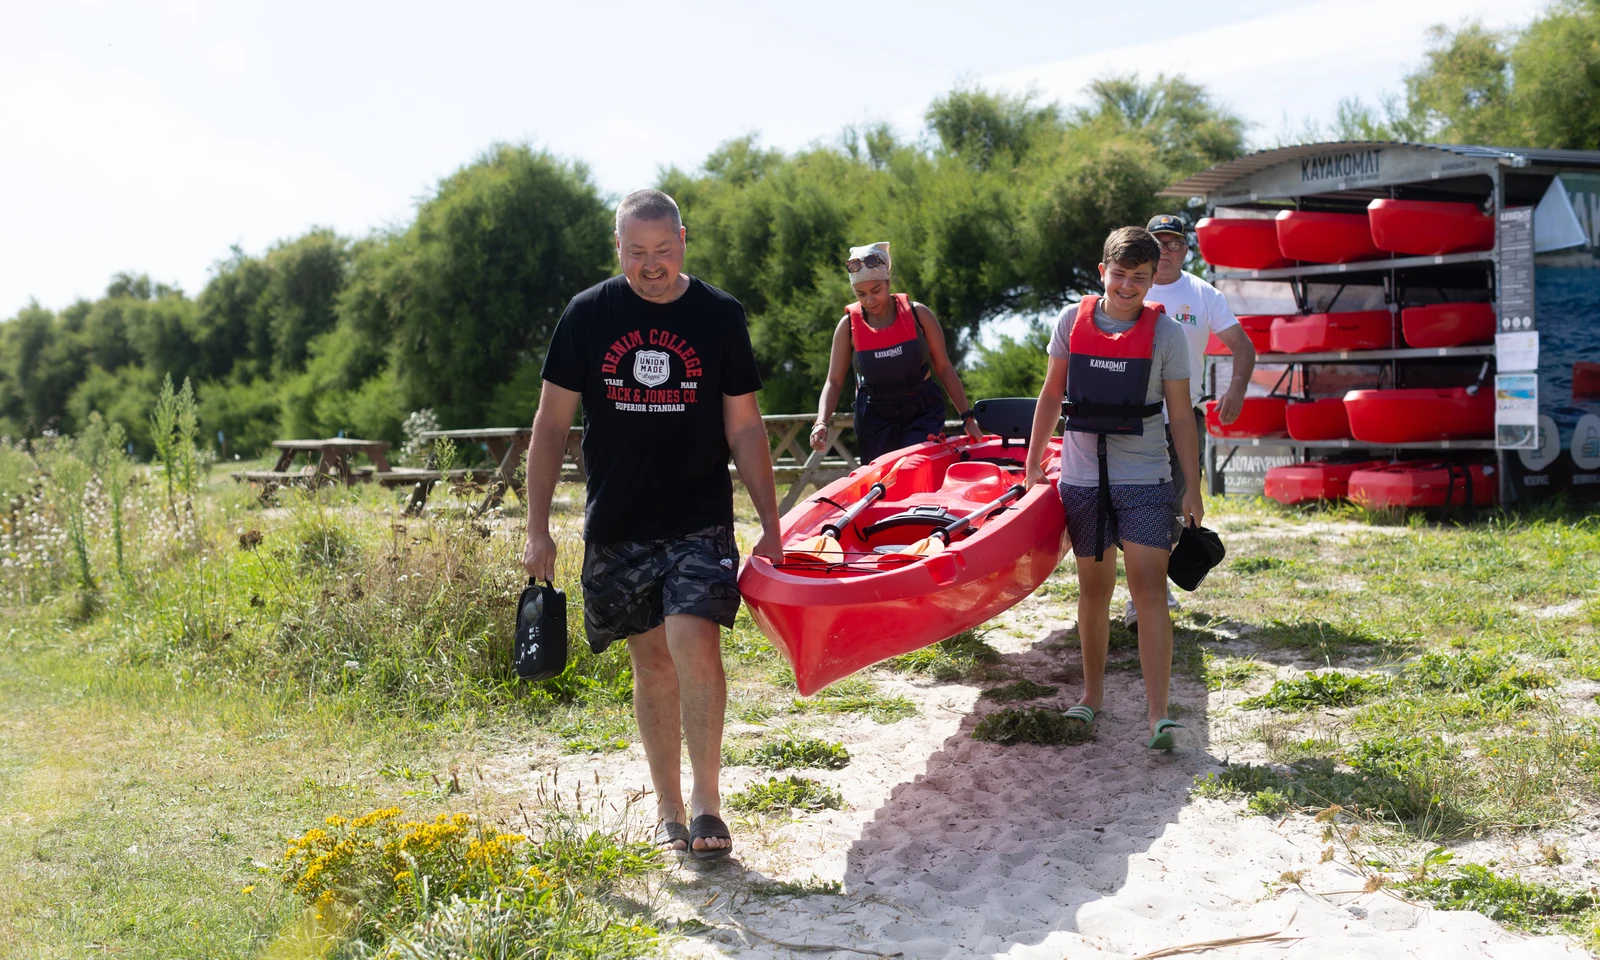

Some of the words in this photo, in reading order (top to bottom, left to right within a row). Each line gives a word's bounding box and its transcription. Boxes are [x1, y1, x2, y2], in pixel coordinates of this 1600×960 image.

[1302, 150, 1381, 181] KAYAKOMAT
[1175, 313, 1197, 323] UFR
[601, 330, 644, 374] DENIM
[649, 328, 702, 378] COLLEGE
[874, 345, 903, 358] KAYAKOMAT
[640, 357, 665, 366] UNION
[1089, 358, 1128, 370] KAYAKOMAT
[640, 365, 663, 374] MADE
[603, 378, 624, 387] TRADE
[680, 381, 698, 389] MARK
[606, 385, 632, 402] JACK
[633, 388, 641, 402] &
[643, 389, 680, 403] JONES
[683, 389, 698, 403] CO.
[615, 401, 647, 412] SUPERIOR
[648, 403, 685, 412] STANDARD
